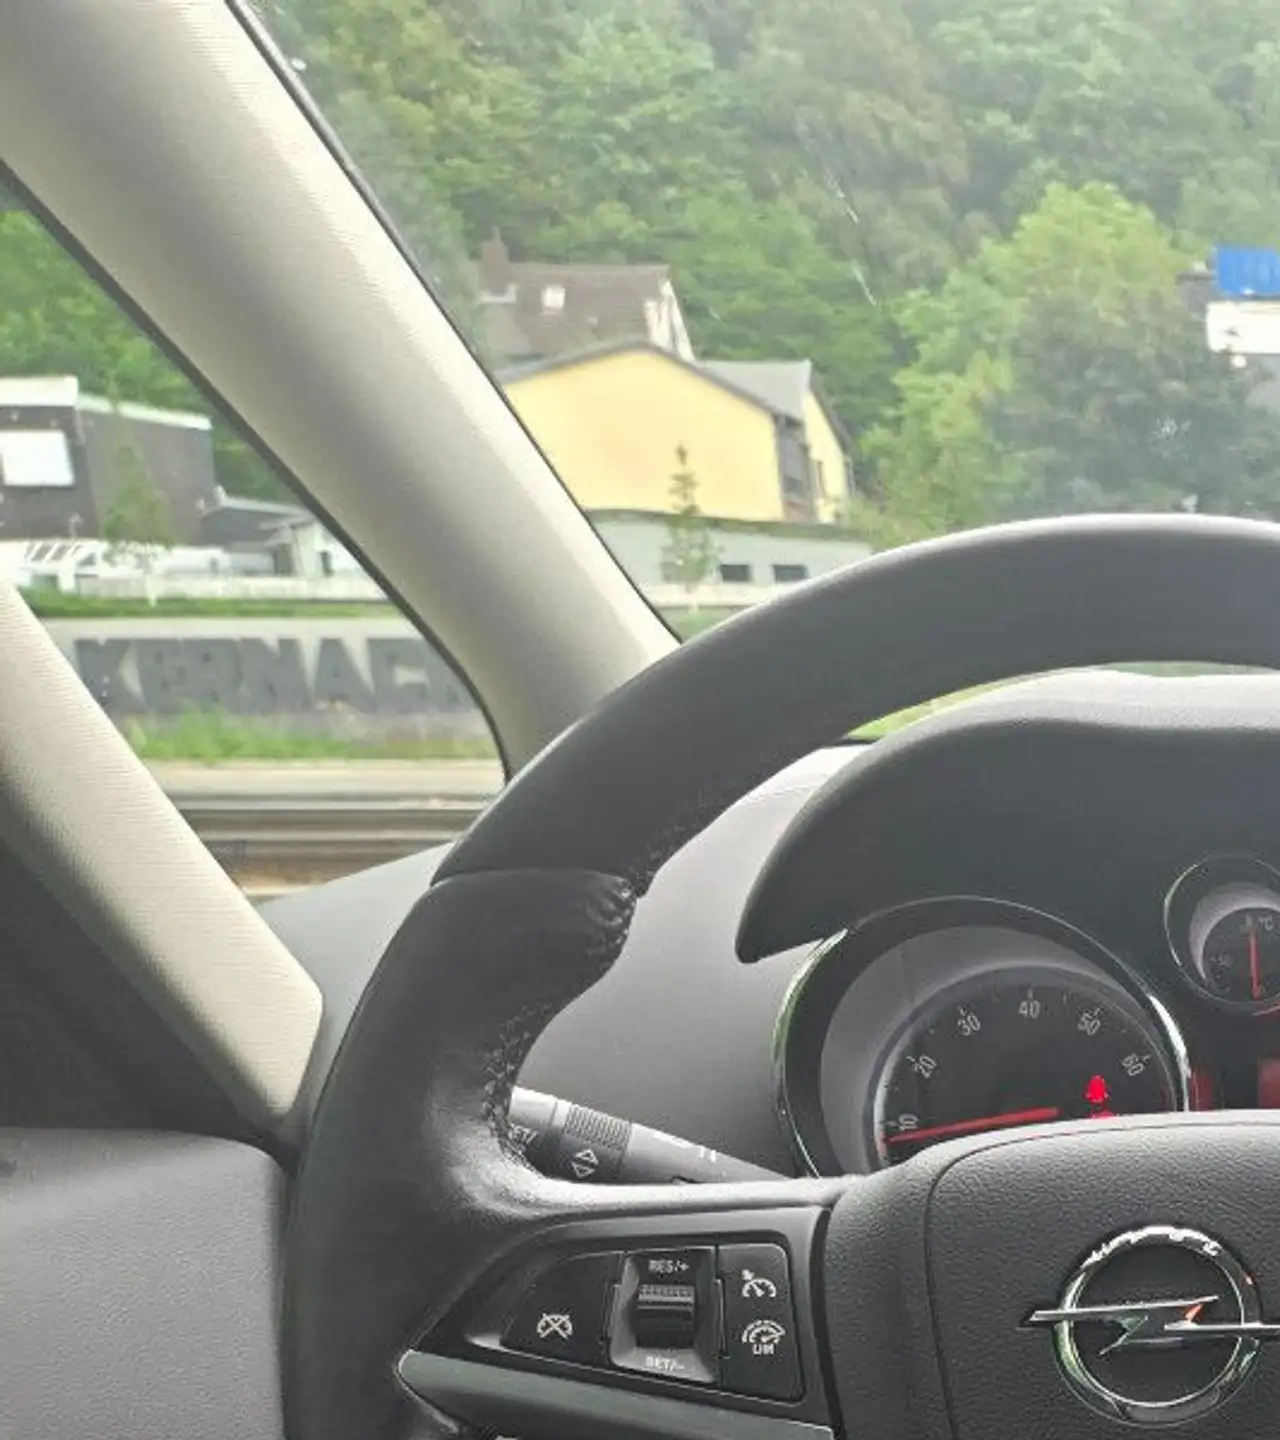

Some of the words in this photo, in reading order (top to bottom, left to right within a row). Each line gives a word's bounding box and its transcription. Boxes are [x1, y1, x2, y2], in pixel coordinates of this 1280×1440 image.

[1018, 1000, 1041, 1018] 40
[957, 1013, 981, 1036] 30
[1077, 1010, 1101, 1035] 50
[914, 1055, 938, 1079] 20
[1121, 1053, 1145, 1077] 60
